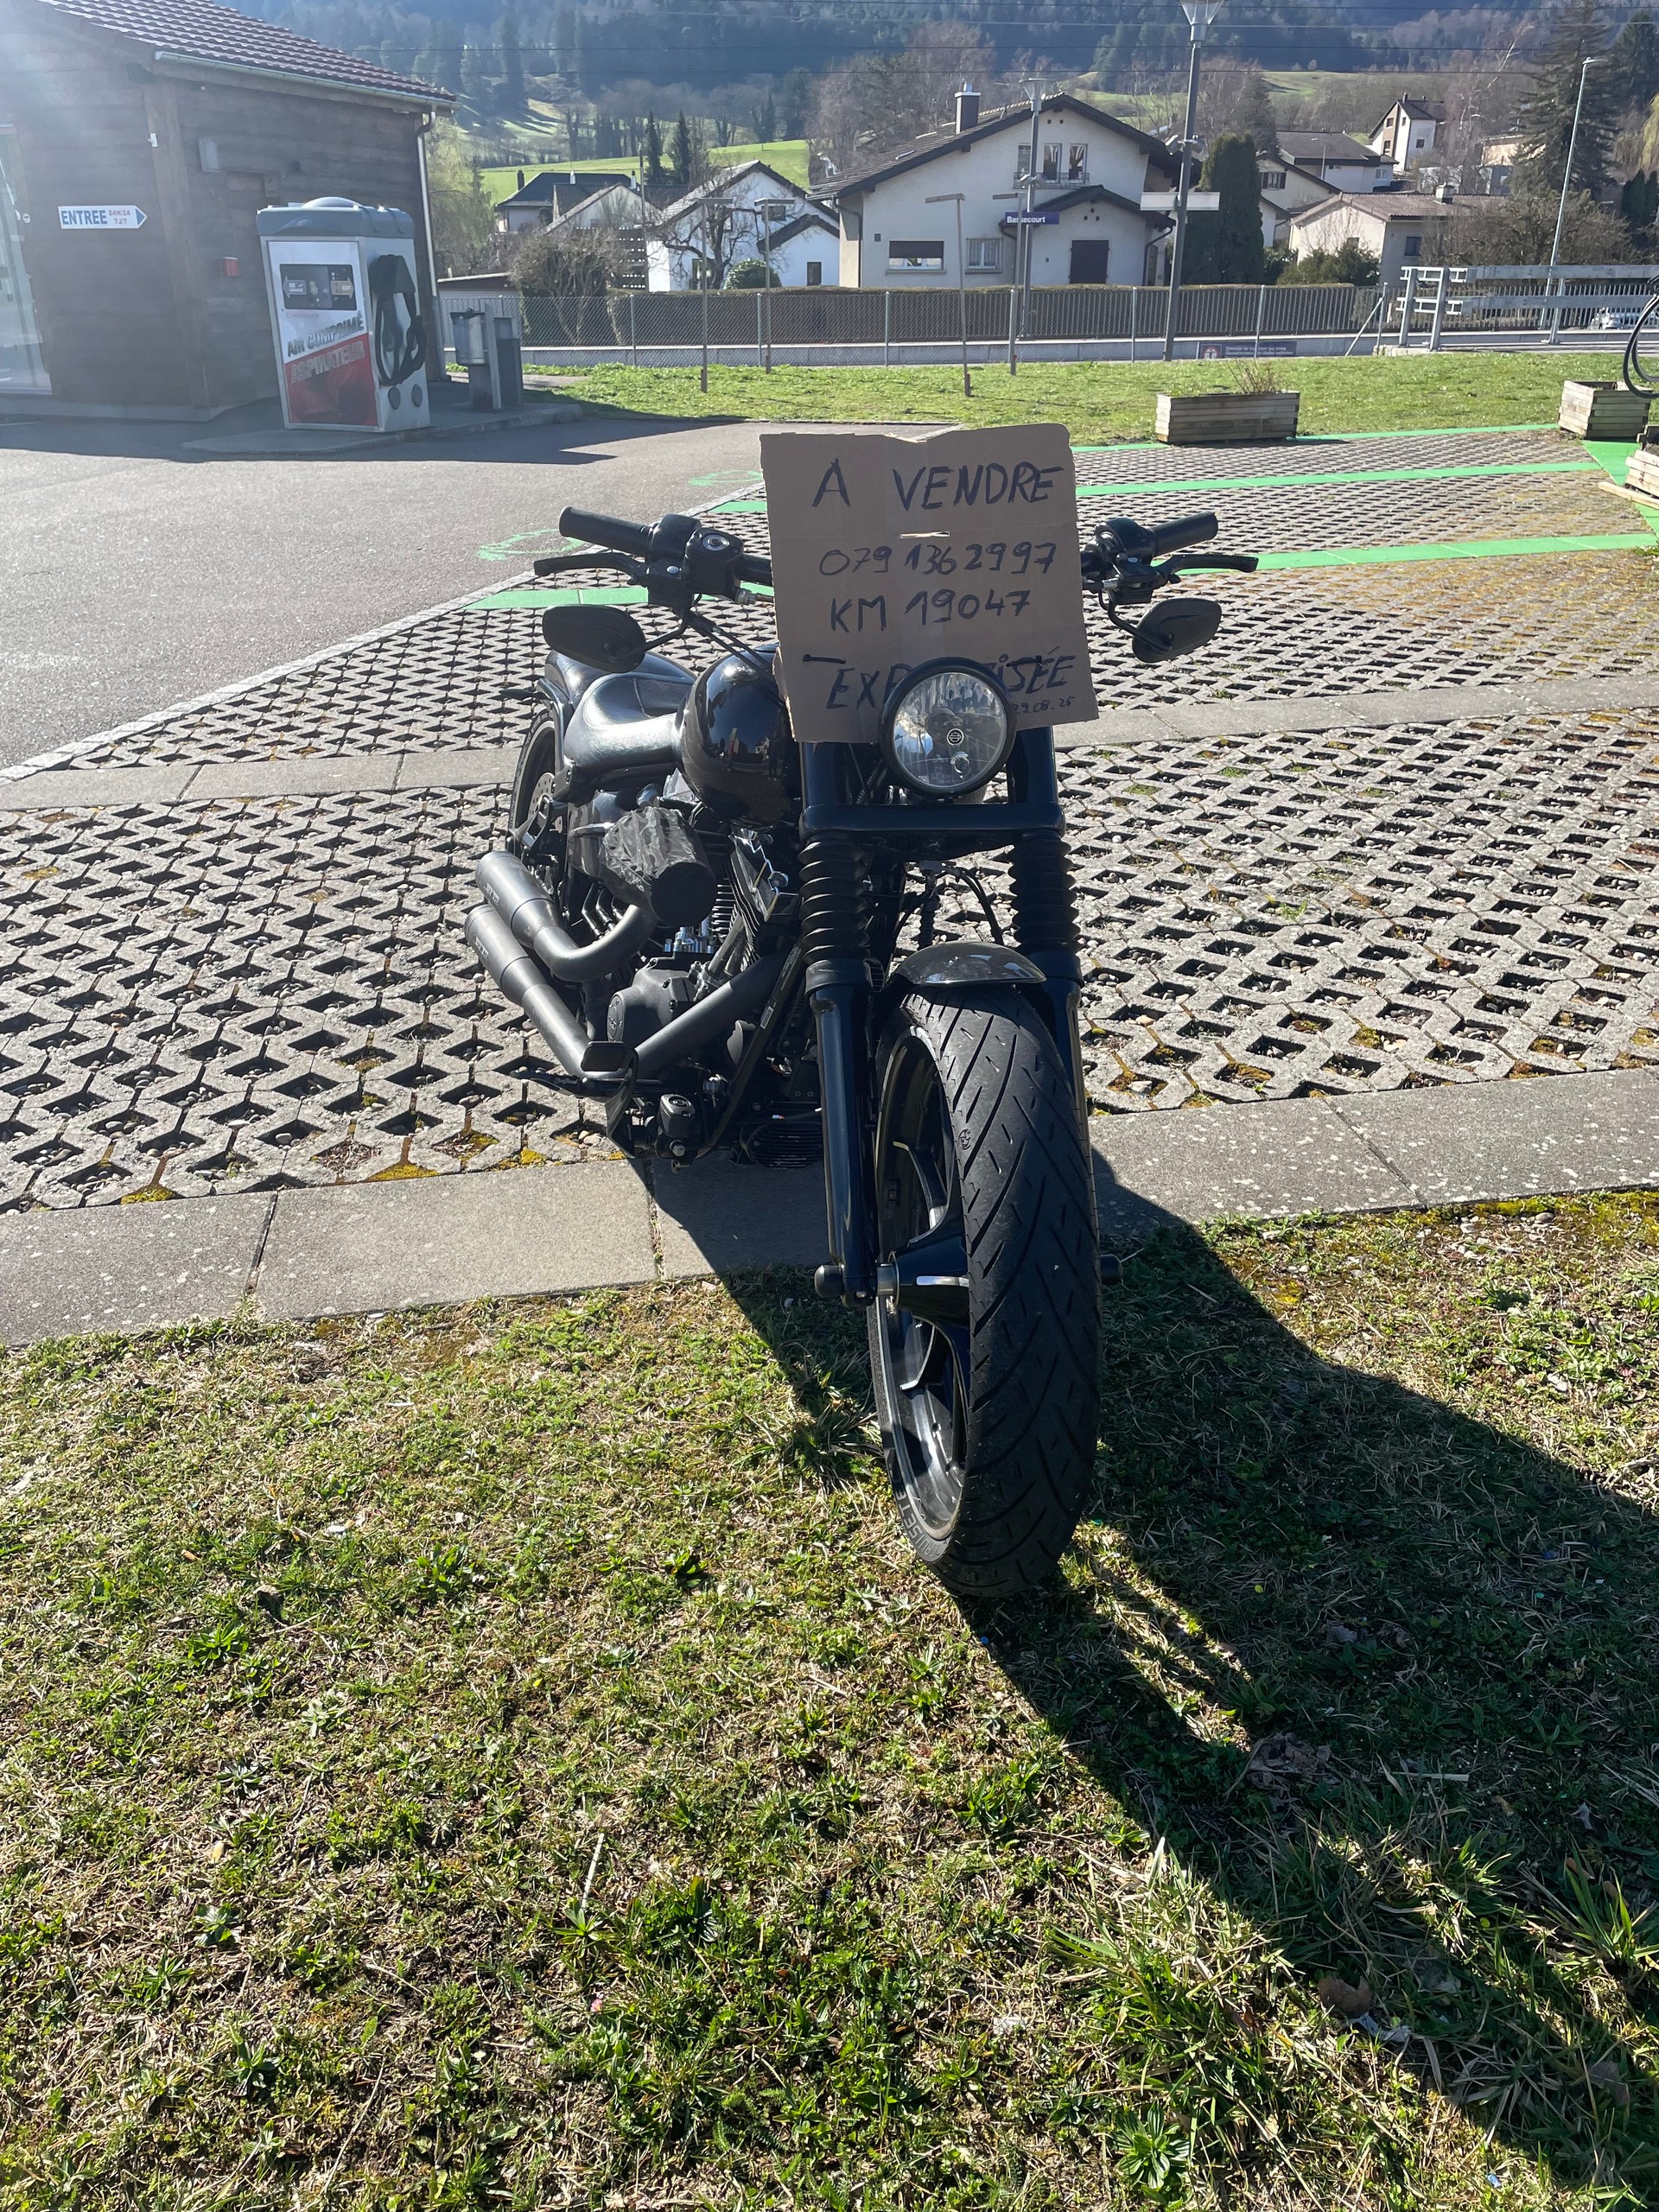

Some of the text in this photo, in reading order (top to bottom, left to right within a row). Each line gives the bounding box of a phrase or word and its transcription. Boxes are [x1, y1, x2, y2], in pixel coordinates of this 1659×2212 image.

[60, 210, 108, 225] ENTREE
[287, 337, 306, 357] AIR
[291, 340, 365, 384] ASPIRATEUR
[811, 457, 1065, 511] A VENDRE
[830, 588, 1031, 632] KM 19047
